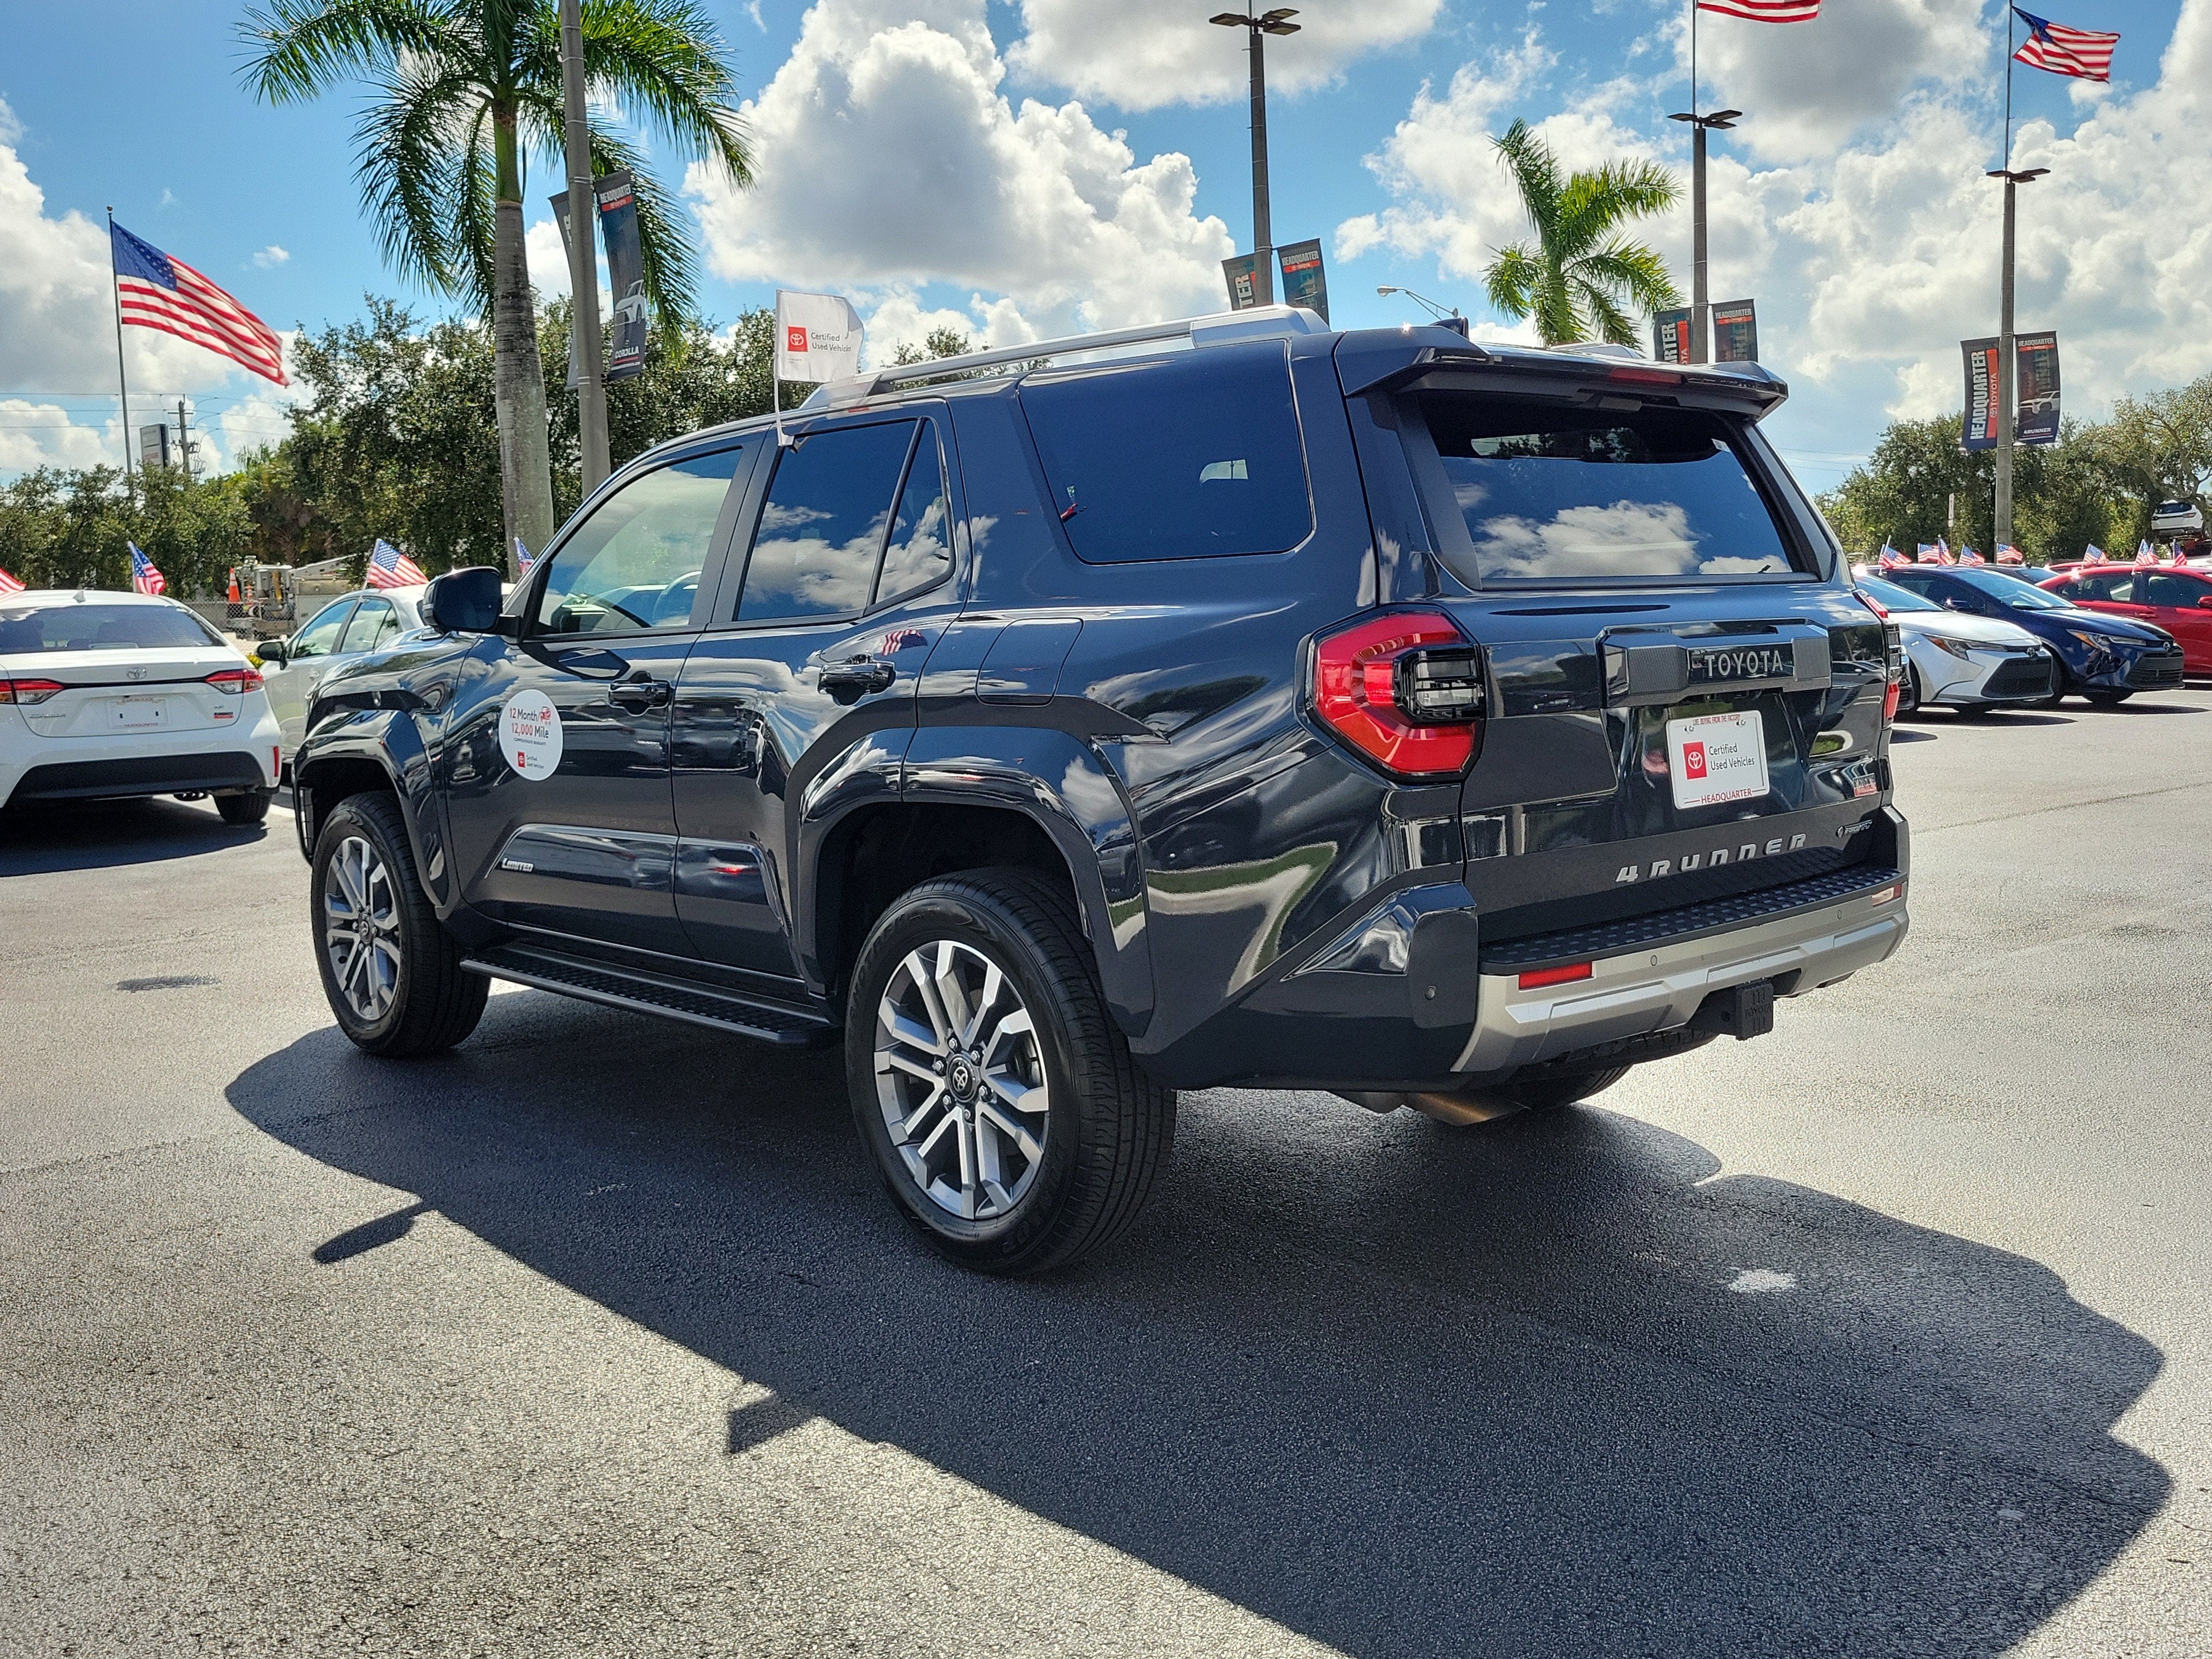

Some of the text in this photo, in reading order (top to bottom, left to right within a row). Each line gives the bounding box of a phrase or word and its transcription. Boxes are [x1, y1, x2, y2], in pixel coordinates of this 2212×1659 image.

[1282, 250, 1319, 266] HEADQUARTER
[1715, 308, 1752, 319] HEADQUARTER
[811, 332, 840, 341] Certified
[2018, 338, 2054, 347] HEADQUARTER
[812, 342, 828, 350] Used
[1970, 351, 1989, 439] HEADQUARTER
[1704, 650, 1783, 678] TOYOTA
[510, 707, 516, 719] 12
[512, 723, 549, 738] 12,000 Mile
[1709, 743, 1738, 756] Certified
[1711, 756, 1754, 771] Used Vehicles
[1702, 788, 1752, 804] HEADQUARTER
[1615, 833, 1806, 882] 4RUNNER
